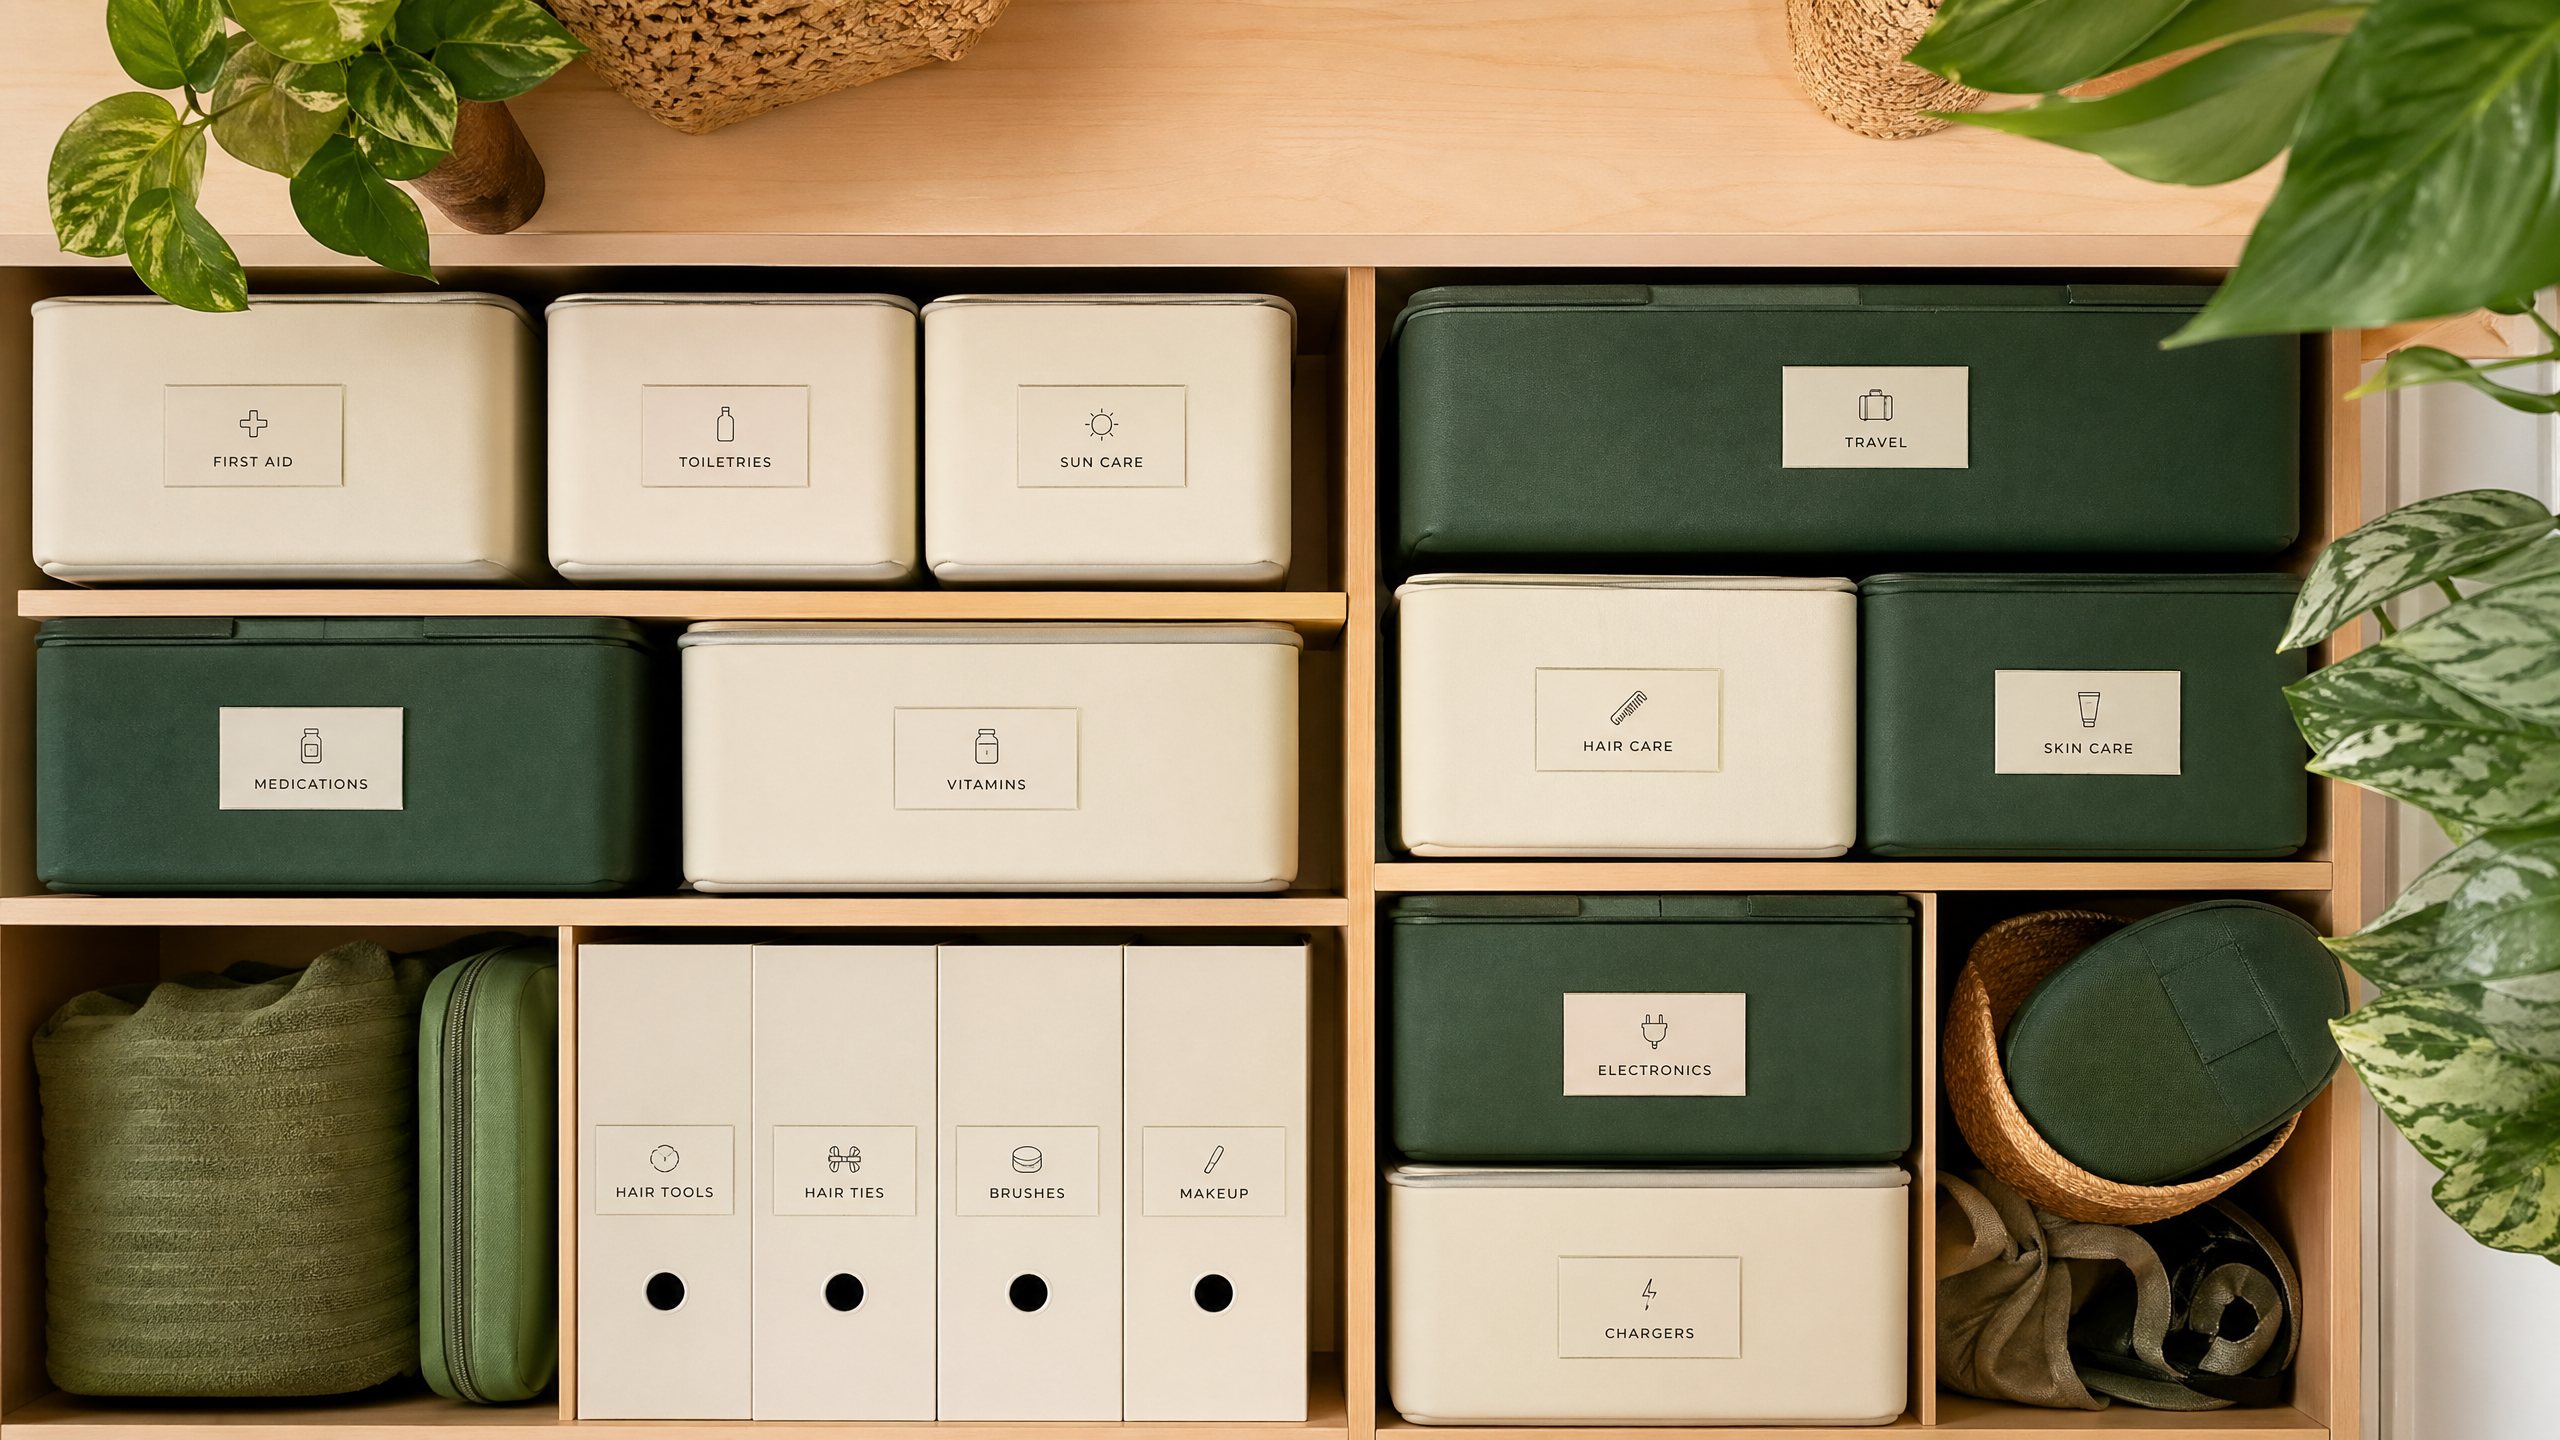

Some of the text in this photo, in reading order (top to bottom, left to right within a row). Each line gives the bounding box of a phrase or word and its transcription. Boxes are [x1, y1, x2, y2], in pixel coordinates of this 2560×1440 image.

[1844, 436, 1908, 449] TRAVEL
[213, 456, 293, 468] FIRST AID
[678, 456, 772, 468] TOILETRIES
[1060, 456, 1143, 468] SUN CARE
[1583, 740, 1673, 752] HAIR CARE
[2043, 742, 2133, 755] SKIN CARE
[254, 778, 368, 790] MEDICATIONS
[946, 778, 1026, 791] VITAMINS
[1598, 1064, 1712, 1076] ELECTRONICS
[616, 1186, 714, 1198] HAIR TOOLS
[805, 1187, 884, 1199] HAIR TIES
[989, 1187, 1065, 1199] BRUSHES
[1180, 1188, 1249, 1200] MAKEUP
[1604, 1327, 1695, 1340] CHARGERS
